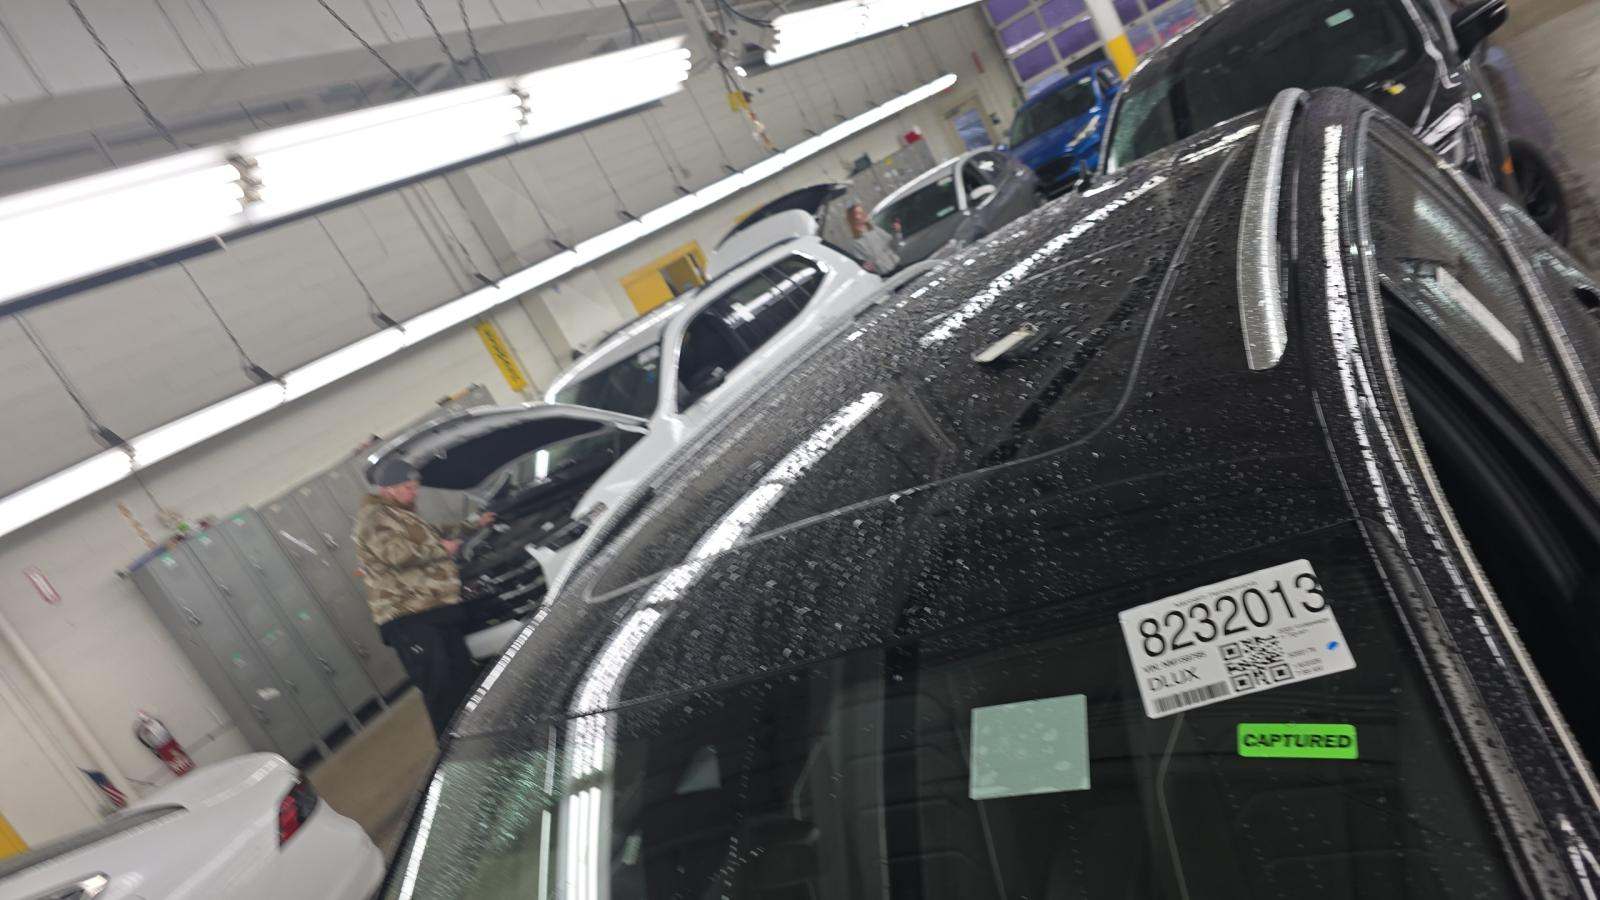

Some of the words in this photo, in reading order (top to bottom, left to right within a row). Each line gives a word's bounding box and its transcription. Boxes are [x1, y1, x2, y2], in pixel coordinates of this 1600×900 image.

[1139, 572, 1326, 657] 8232013
[1149, 667, 1200, 691] DLUX
[1244, 733, 1352, 749] CAPTURED
